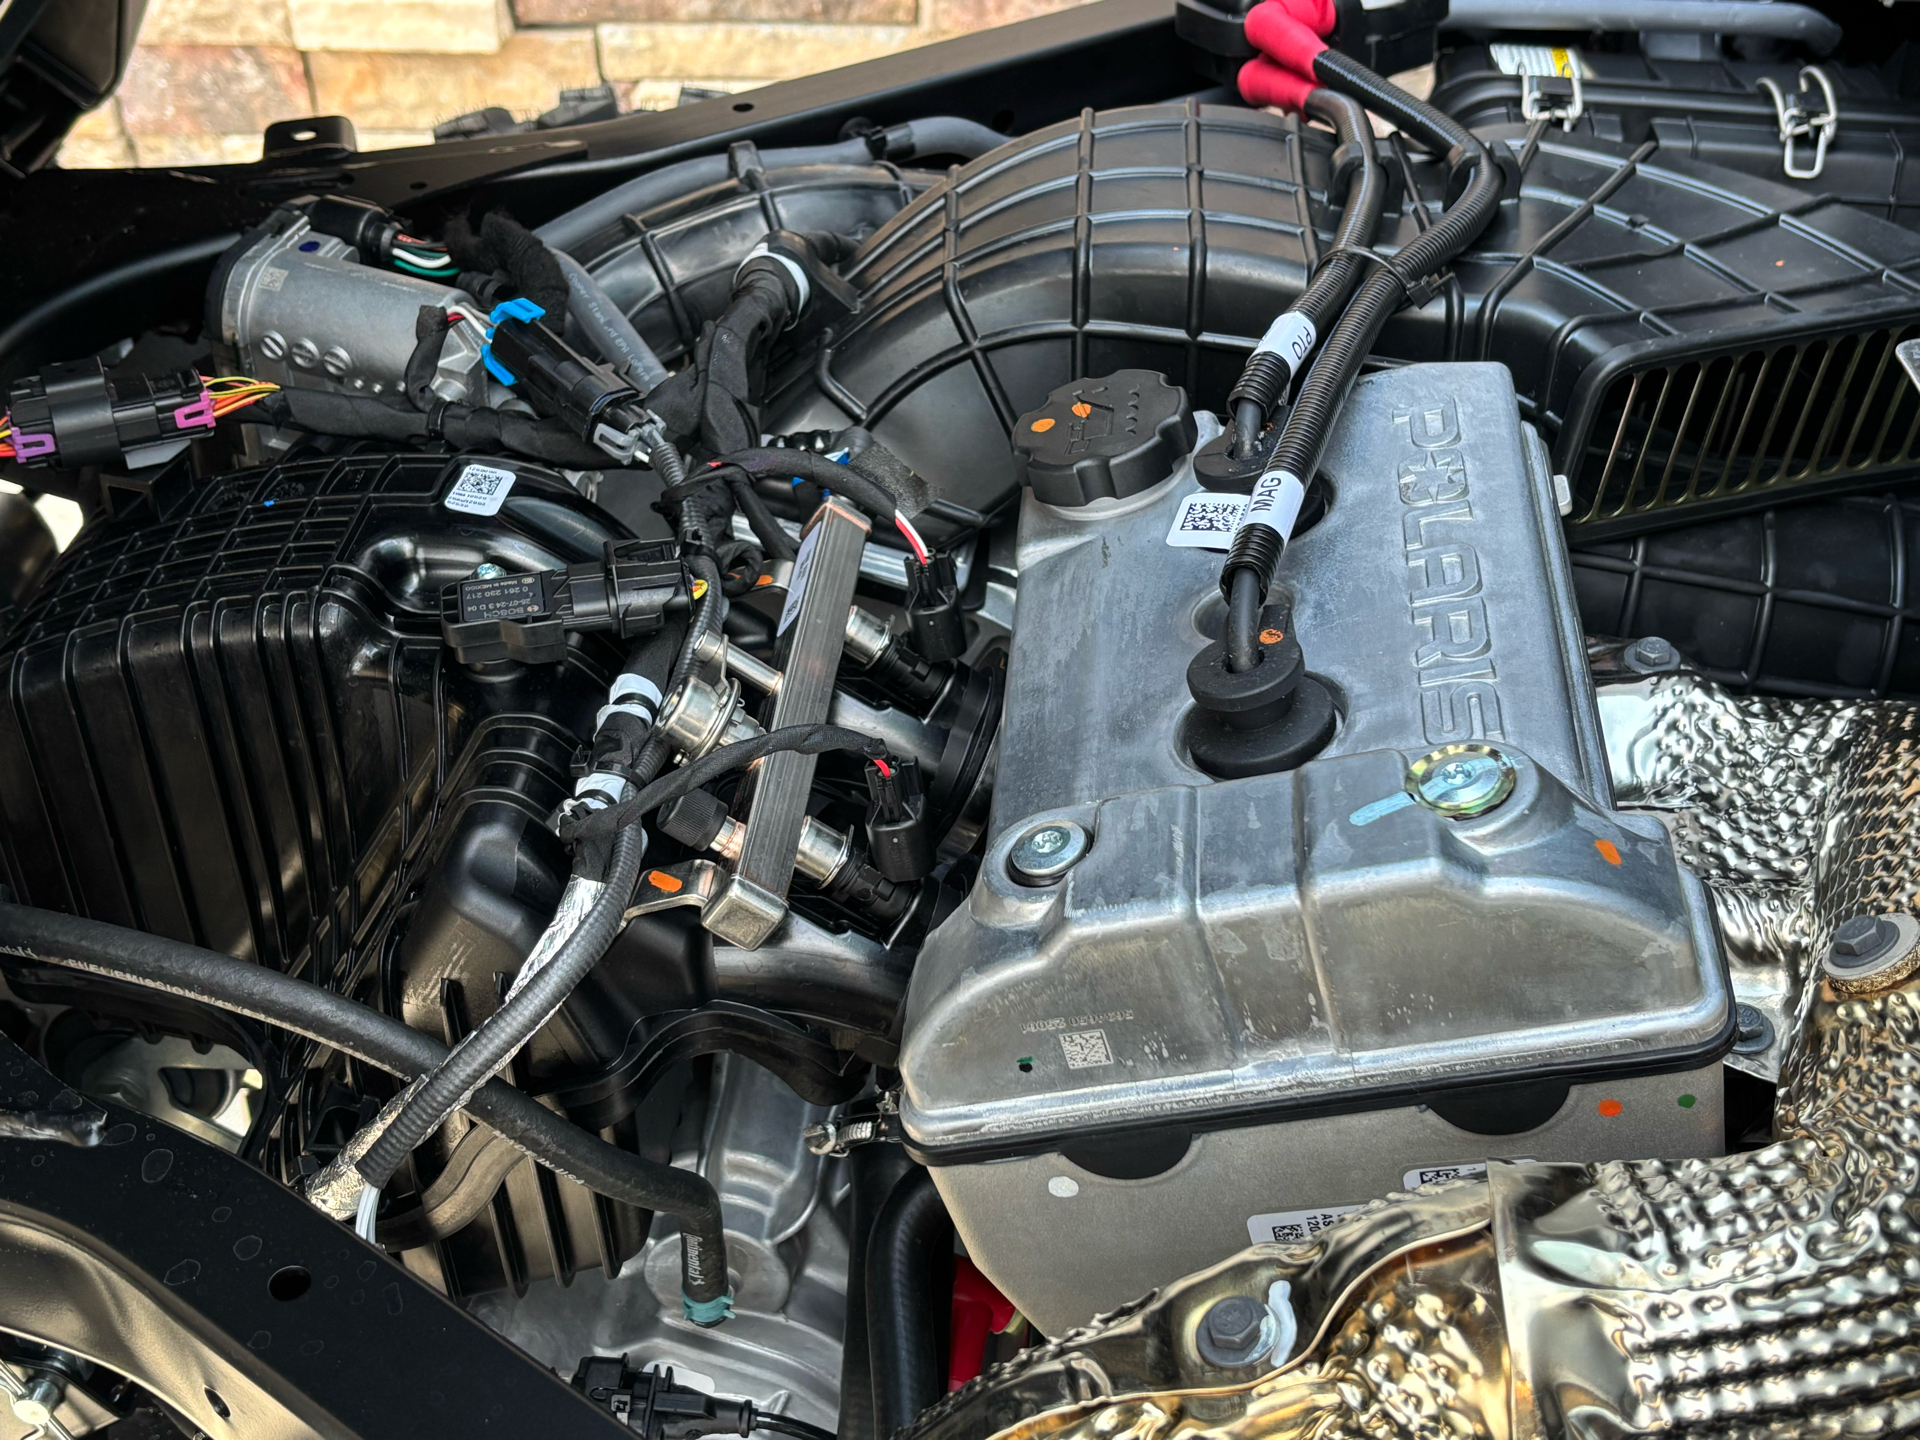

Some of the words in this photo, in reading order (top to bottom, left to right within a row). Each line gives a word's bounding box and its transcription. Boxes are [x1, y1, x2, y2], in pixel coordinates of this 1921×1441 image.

[1291, 325, 1313, 361] PTO
[1250, 476, 1282, 512] MAG
[1391, 397, 1506, 746] POLARIS
[466, 591, 483, 600] 217
[484, 589, 501, 598] 230
[467, 604, 478, 612] 04
[479, 603, 487, 611] D
[484, 606, 525, 619] BOSCH
[492, 1129, 538, 1158] MADE
[536, 1157, 556, 1169] IN
[682, 1232, 705, 1279] Continental
